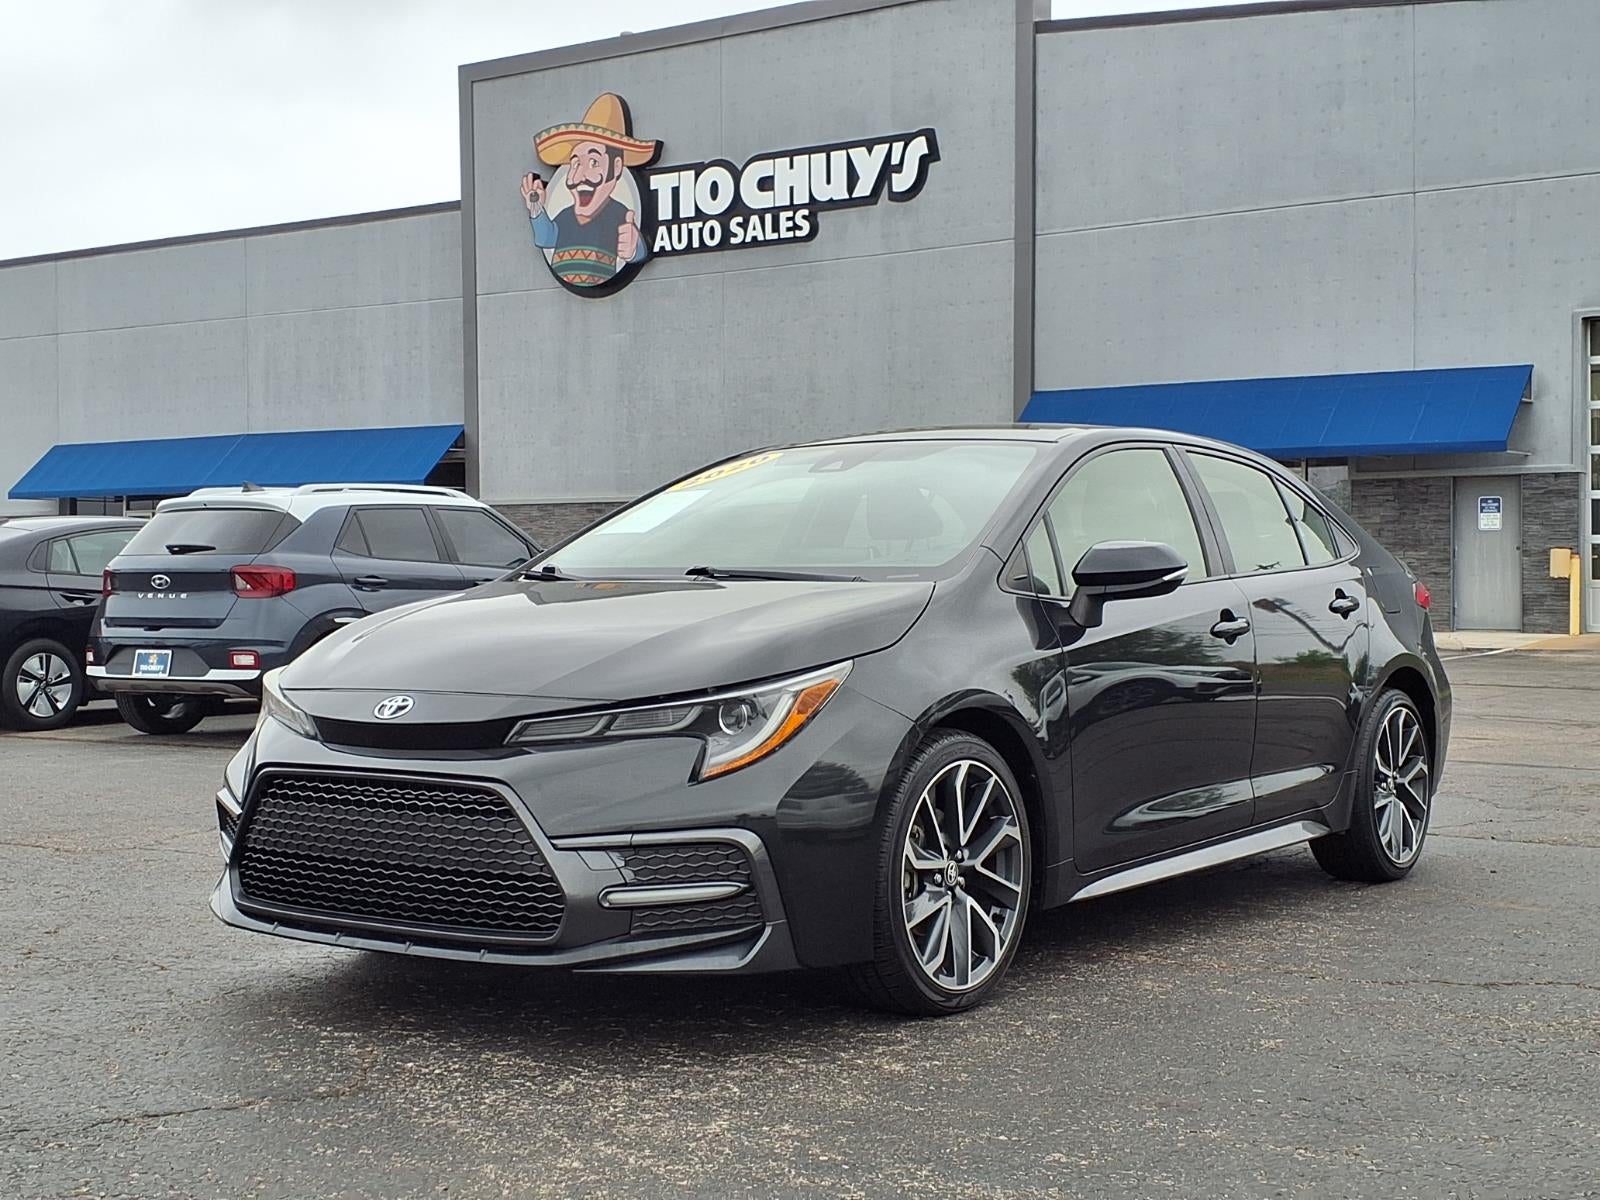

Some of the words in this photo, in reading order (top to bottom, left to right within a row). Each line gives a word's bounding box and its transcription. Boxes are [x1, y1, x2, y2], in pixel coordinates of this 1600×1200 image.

[650, 166, 734, 220] TIO
[740, 136, 928, 209] CHUY'S
[653, 219, 721, 252] AUTO
[730, 209, 810, 244] SALES
